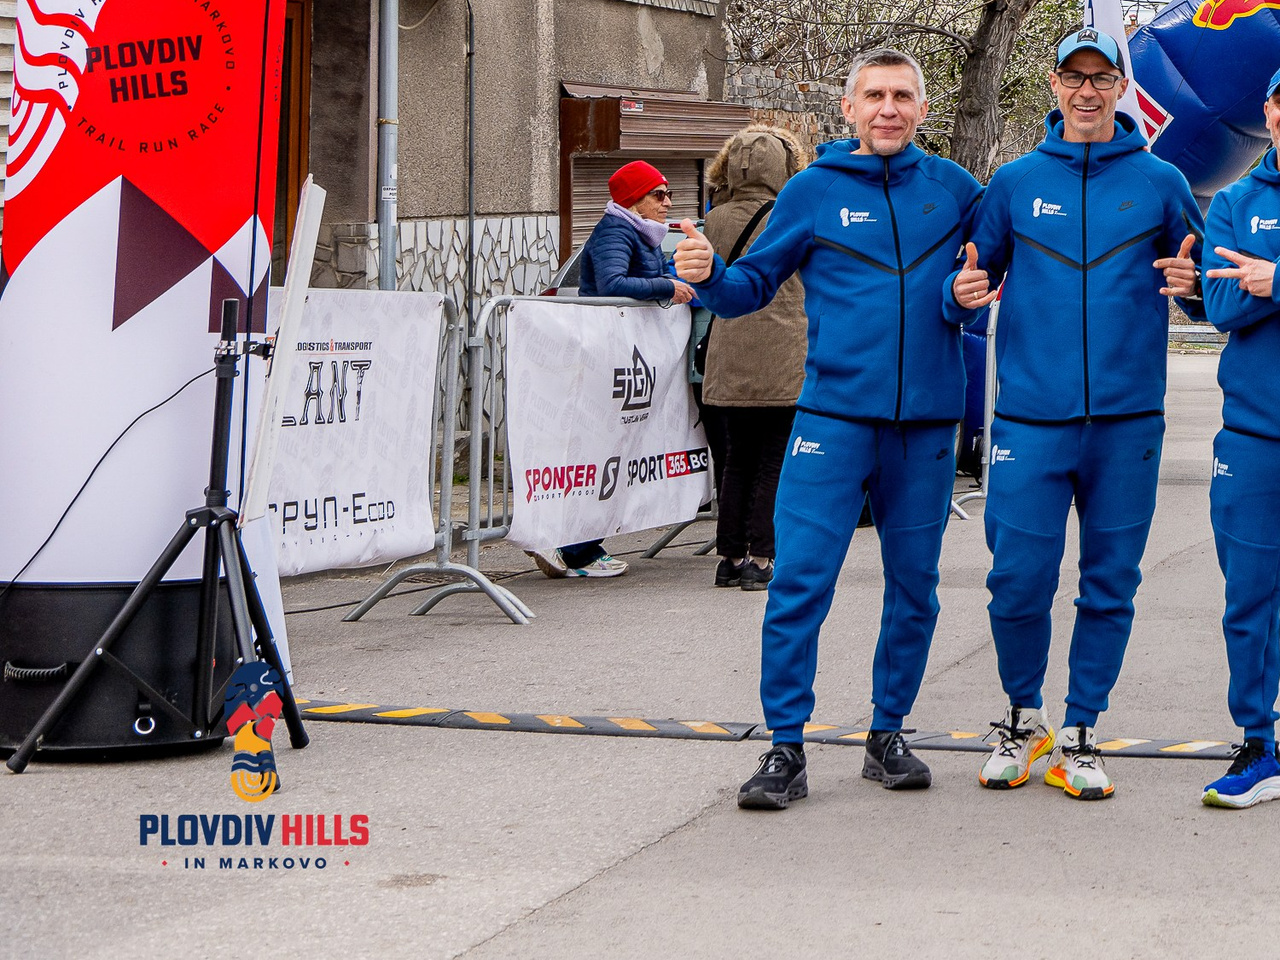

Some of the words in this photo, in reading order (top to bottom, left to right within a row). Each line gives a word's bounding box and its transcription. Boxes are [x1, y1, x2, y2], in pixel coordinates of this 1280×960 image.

[58, 8, 86, 90] PLOVDIV
[85, 35, 203, 73] PLOVDIV
[109, 70, 189, 104] HILLS
[77, 116, 126, 151] TRAIL
[139, 137, 179, 153] RUN
[187, 102, 225, 141] RACE
[525, 464, 597, 504] SPONSER
